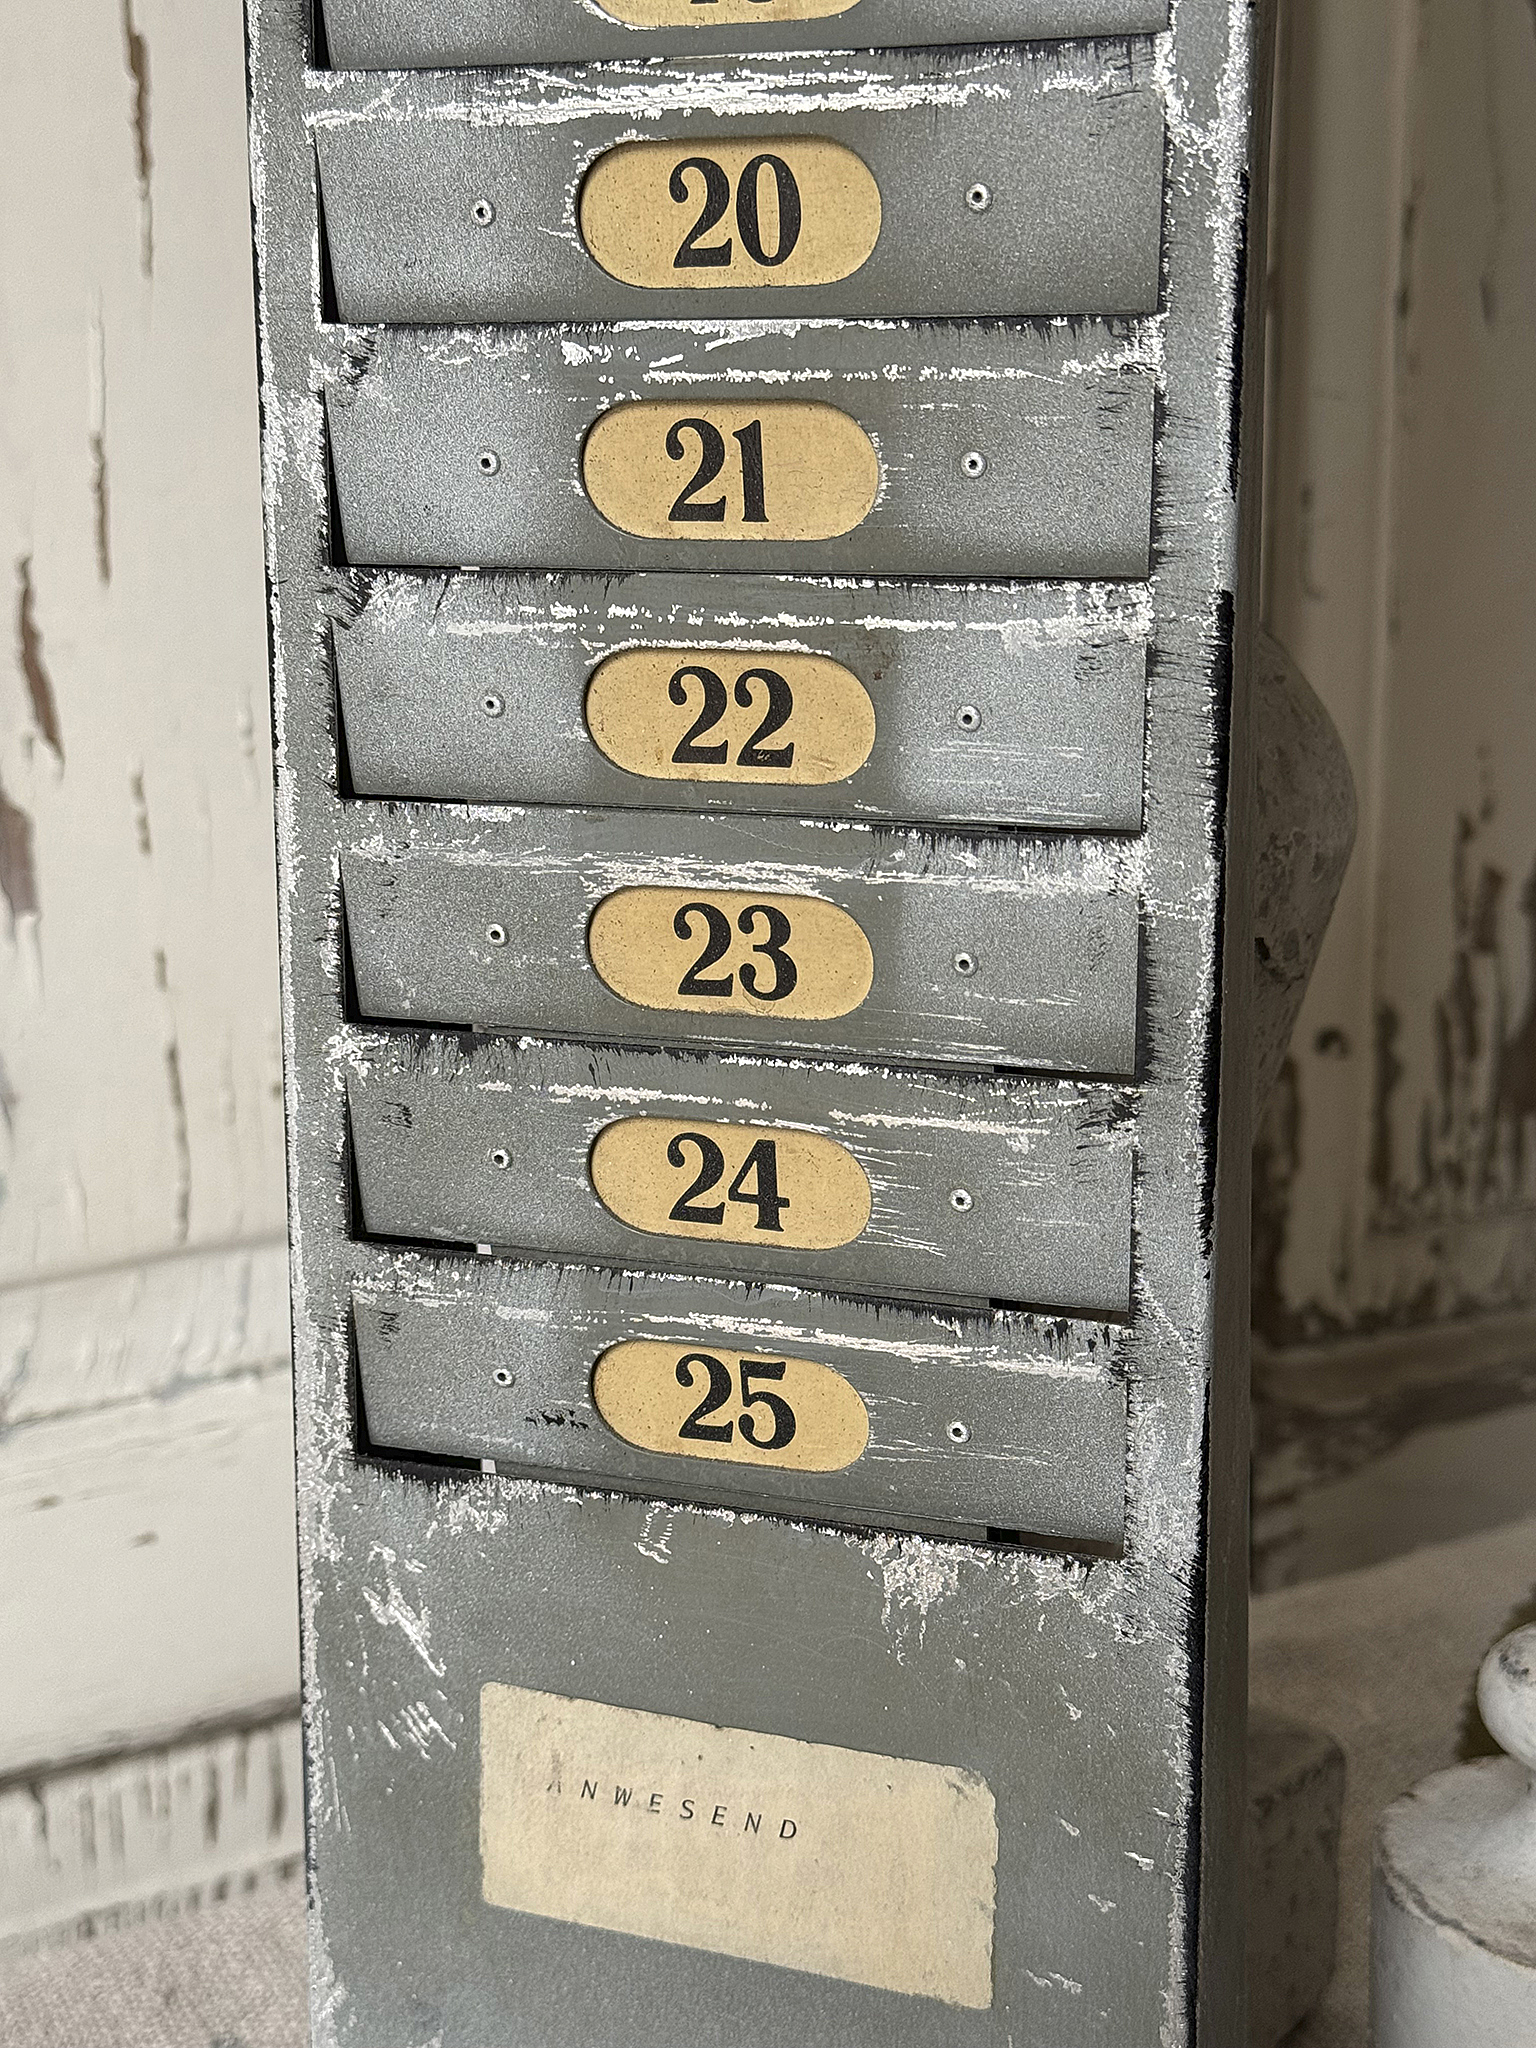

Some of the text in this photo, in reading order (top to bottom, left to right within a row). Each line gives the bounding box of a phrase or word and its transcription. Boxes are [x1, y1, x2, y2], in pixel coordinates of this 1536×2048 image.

[668, 153, 802, 269] 20
[665, 417, 770, 523] 21
[668, 665, 795, 769] 22
[673, 902, 798, 1002] 23
[666, 1132, 791, 1233] 24
[675, 1353, 797, 1450] 25
[547, 1778, 798, 1840] ANWESEND
